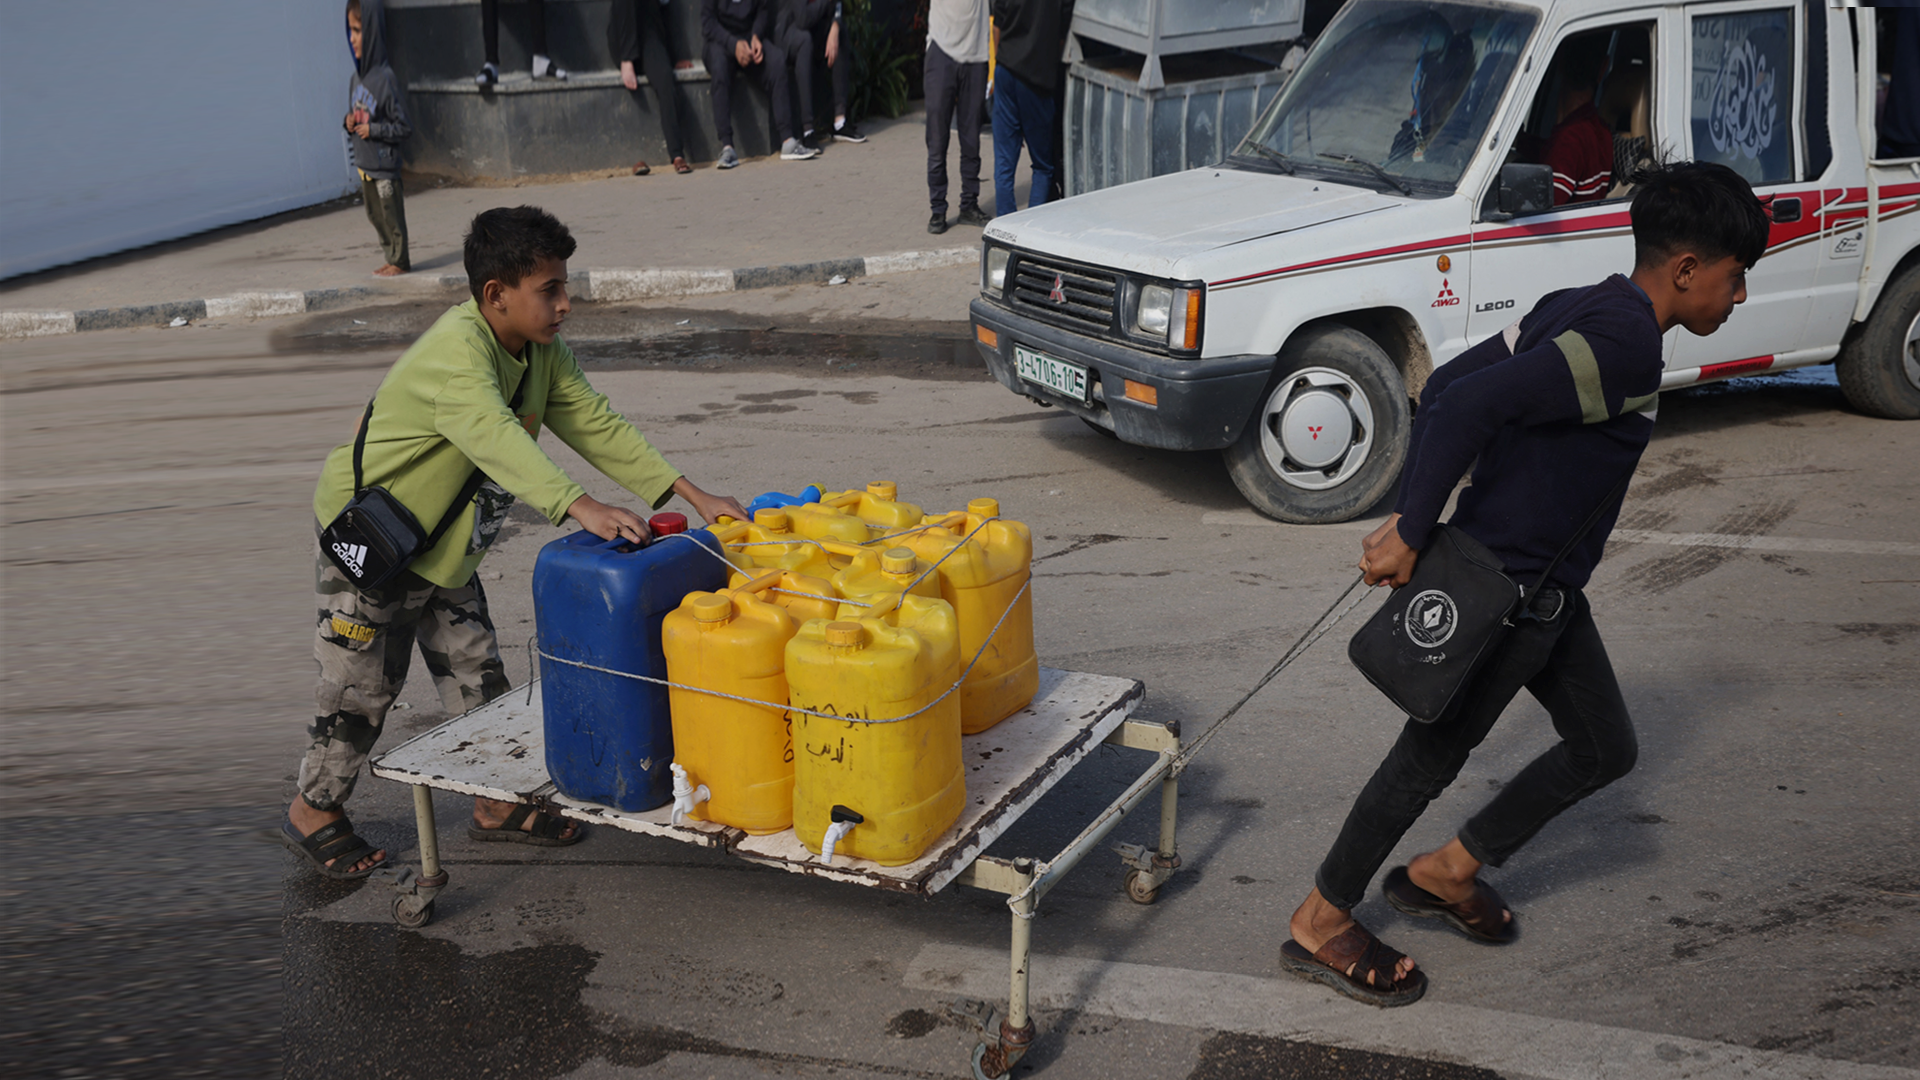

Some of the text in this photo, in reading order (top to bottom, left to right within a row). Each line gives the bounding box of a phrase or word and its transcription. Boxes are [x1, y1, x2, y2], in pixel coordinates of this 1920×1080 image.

[1431, 297, 1460, 308] AWD
[1475, 299, 1515, 313] L200
[331, 542, 364, 579] adidas
